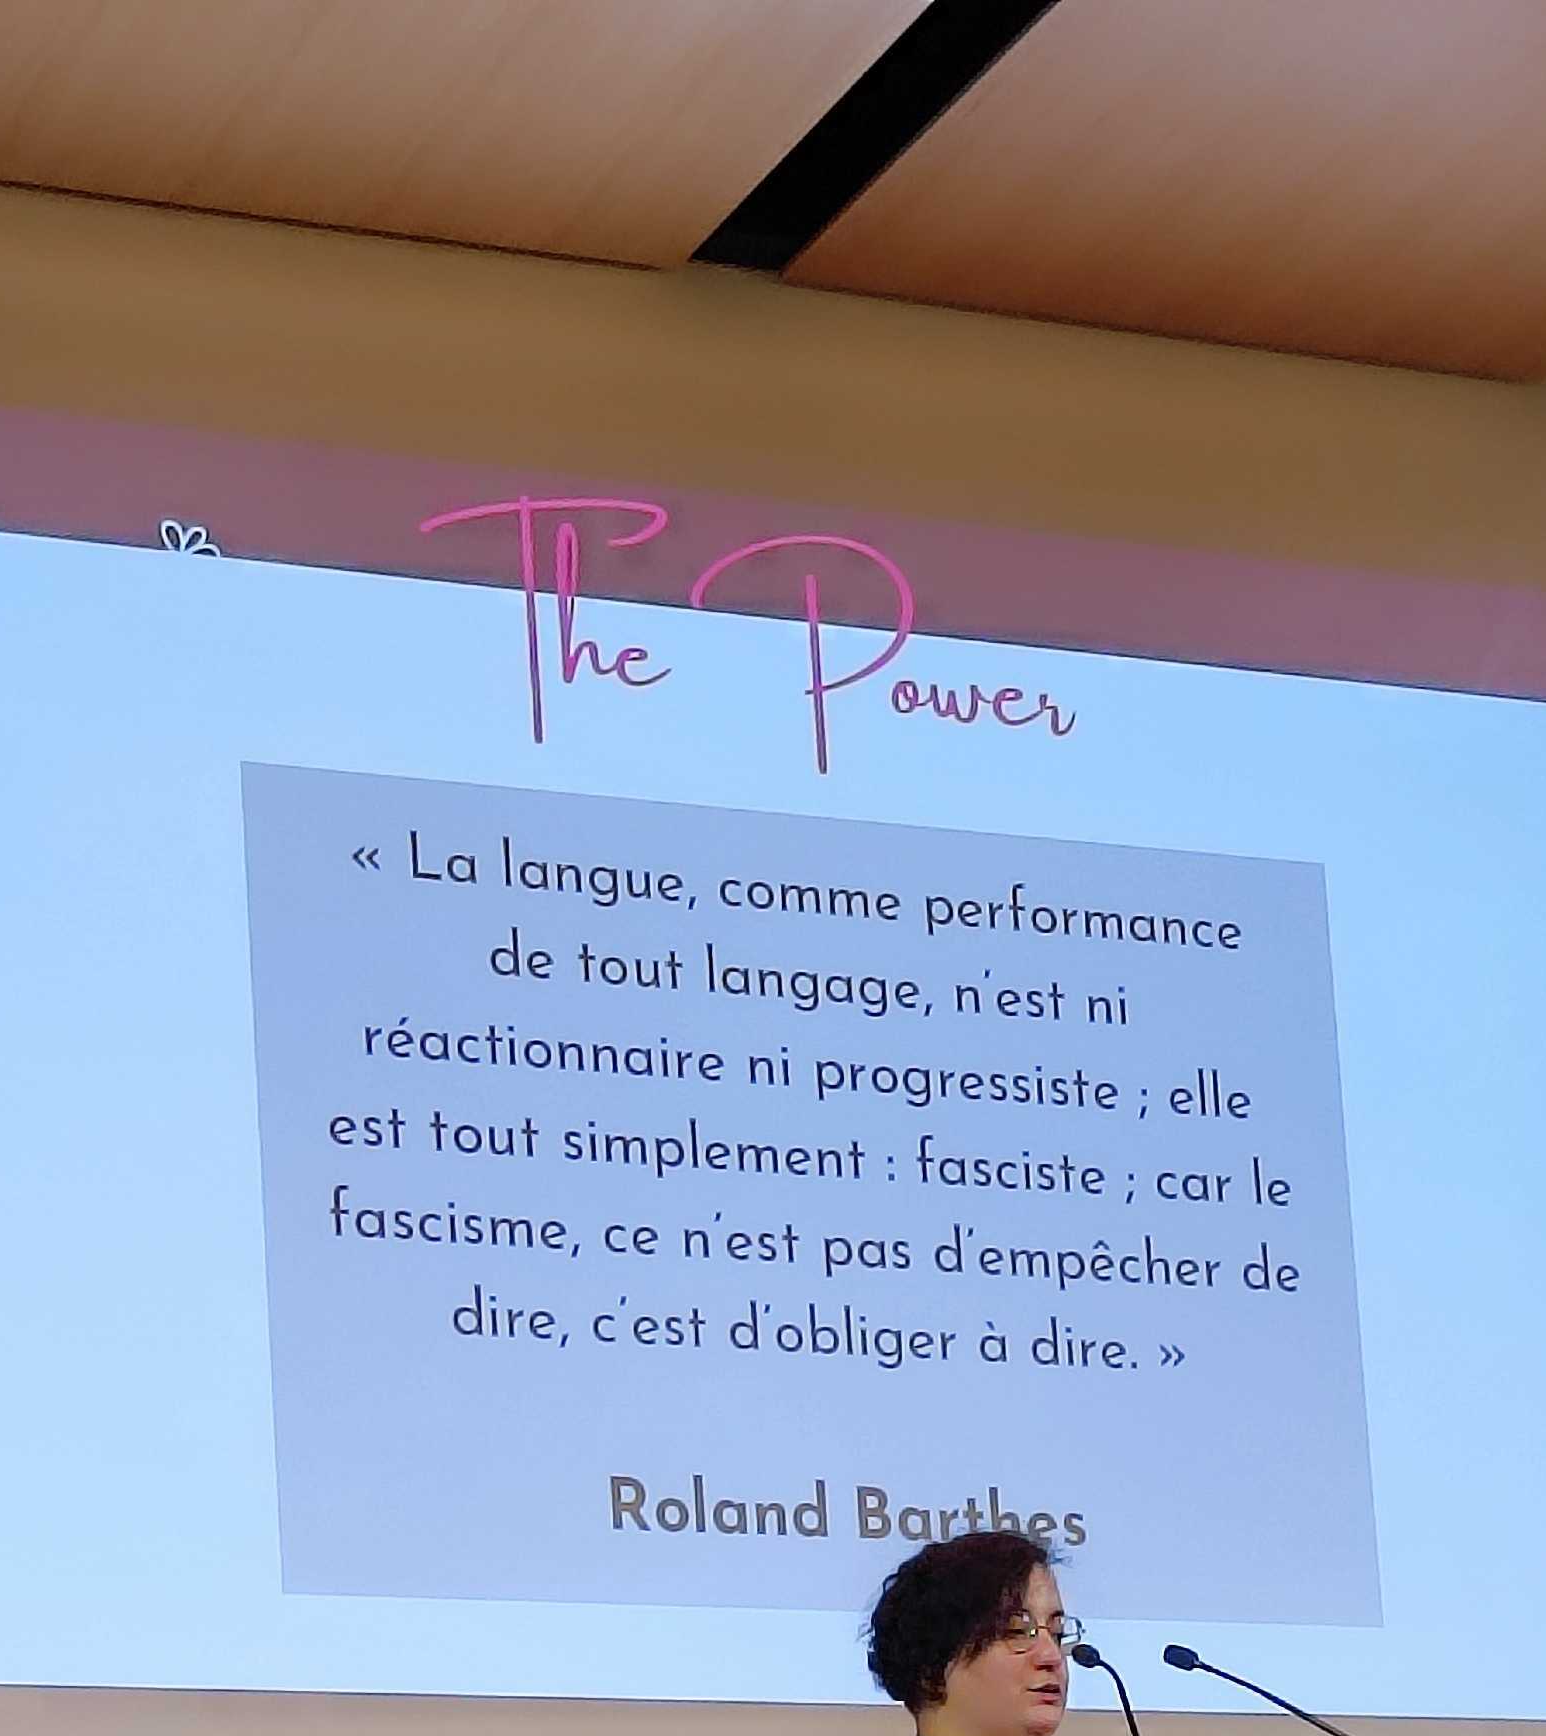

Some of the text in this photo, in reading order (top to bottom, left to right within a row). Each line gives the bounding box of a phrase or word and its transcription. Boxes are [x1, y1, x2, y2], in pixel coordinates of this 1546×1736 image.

[420, 496, 1077, 775] The Power
[408, 828, 479, 886] La
[501, 834, 698, 912] langue,
[718, 878, 903, 922] comme
[924, 881, 1243, 951] performance
[488, 925, 1128, 1027] de tout langage, n'est ni
[363, 1015, 726, 1083] réactionnaire
[747, 1045, 791, 1088] ni
[814, 1059, 1120, 1111] progressiste
[1168, 1066, 1252, 1121] elle
[328, 1107, 408, 1150] est
[427, 1109, 541, 1159] tout
[562, 1116, 867, 1181] simplement
[914, 1133, 1107, 1196] fasciste
[1155, 1171, 1233, 1204] car
[1251, 1155, 1292, 1208] le
[328, 1183, 1301, 1294] fascisme, ce n'est pas d'empêcher de
[451, 1282, 571, 1350] dire,
[591, 1294, 708, 1349] c'est
[728, 1298, 958, 1371] d'obliger
[978, 1319, 1009, 1364] à
[1030, 1314, 1139, 1371] dire.
[608, 1473, 1088, 1548] Roland Barthes
